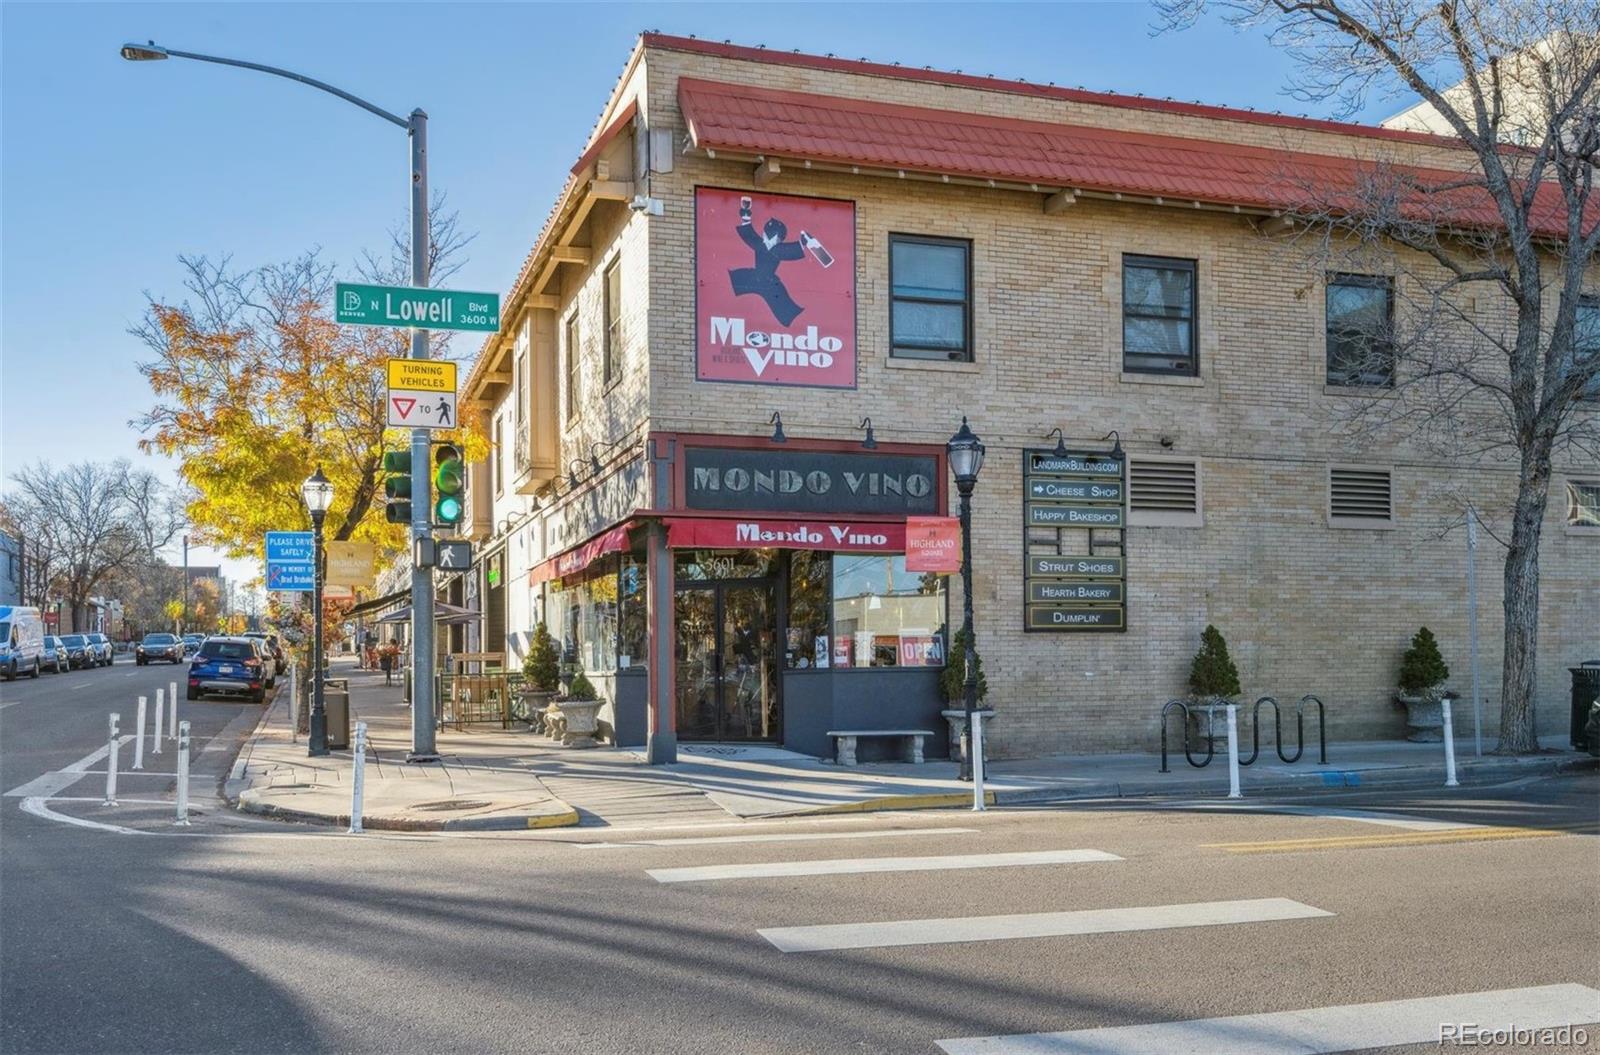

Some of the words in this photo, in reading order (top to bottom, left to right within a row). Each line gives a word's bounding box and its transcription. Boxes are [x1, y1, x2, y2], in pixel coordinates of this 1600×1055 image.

[371, 300, 379, 310] N
[386, 293, 452, 323] Lowell
[468, 302, 488, 312] Blvd
[460, 314, 487, 325] 3600
[489, 316, 497, 325] W
[710, 316, 843, 353] Mondo
[742, 347, 834, 377] Vino
[402, 365, 443, 375] TURNING
[400, 377, 445, 388] VEHICLES
[419, 404, 431, 414] TO
[1033, 458, 1118, 472] LANDMARKBUILDING.COM
[693, 467, 832, 495] MONDO
[843, 471, 931, 497] VINO
[1046, 484, 1085, 496] CHEESE
[1091, 486, 1118, 497] SHOP
[1033, 509, 1066, 520] HAPPY
[1069, 510, 1118, 522] BAKESHOP
[736, 523, 824, 544] Mondo
[828, 526, 887, 545] Vino
[269, 538, 293, 546] PLEASE
[910, 539, 955, 549] HIGHLAND
[280, 548, 304, 556] SAFELY
[1039, 561, 1074, 572] STRUT
[1078, 562, 1114, 573] SHOES
[1041, 587, 1075, 597] HEARTH
[1078, 587, 1111, 598] BAKERY
[1053, 612, 1101, 623] DUMPLIN'
[904, 641, 941, 660] OPEN
